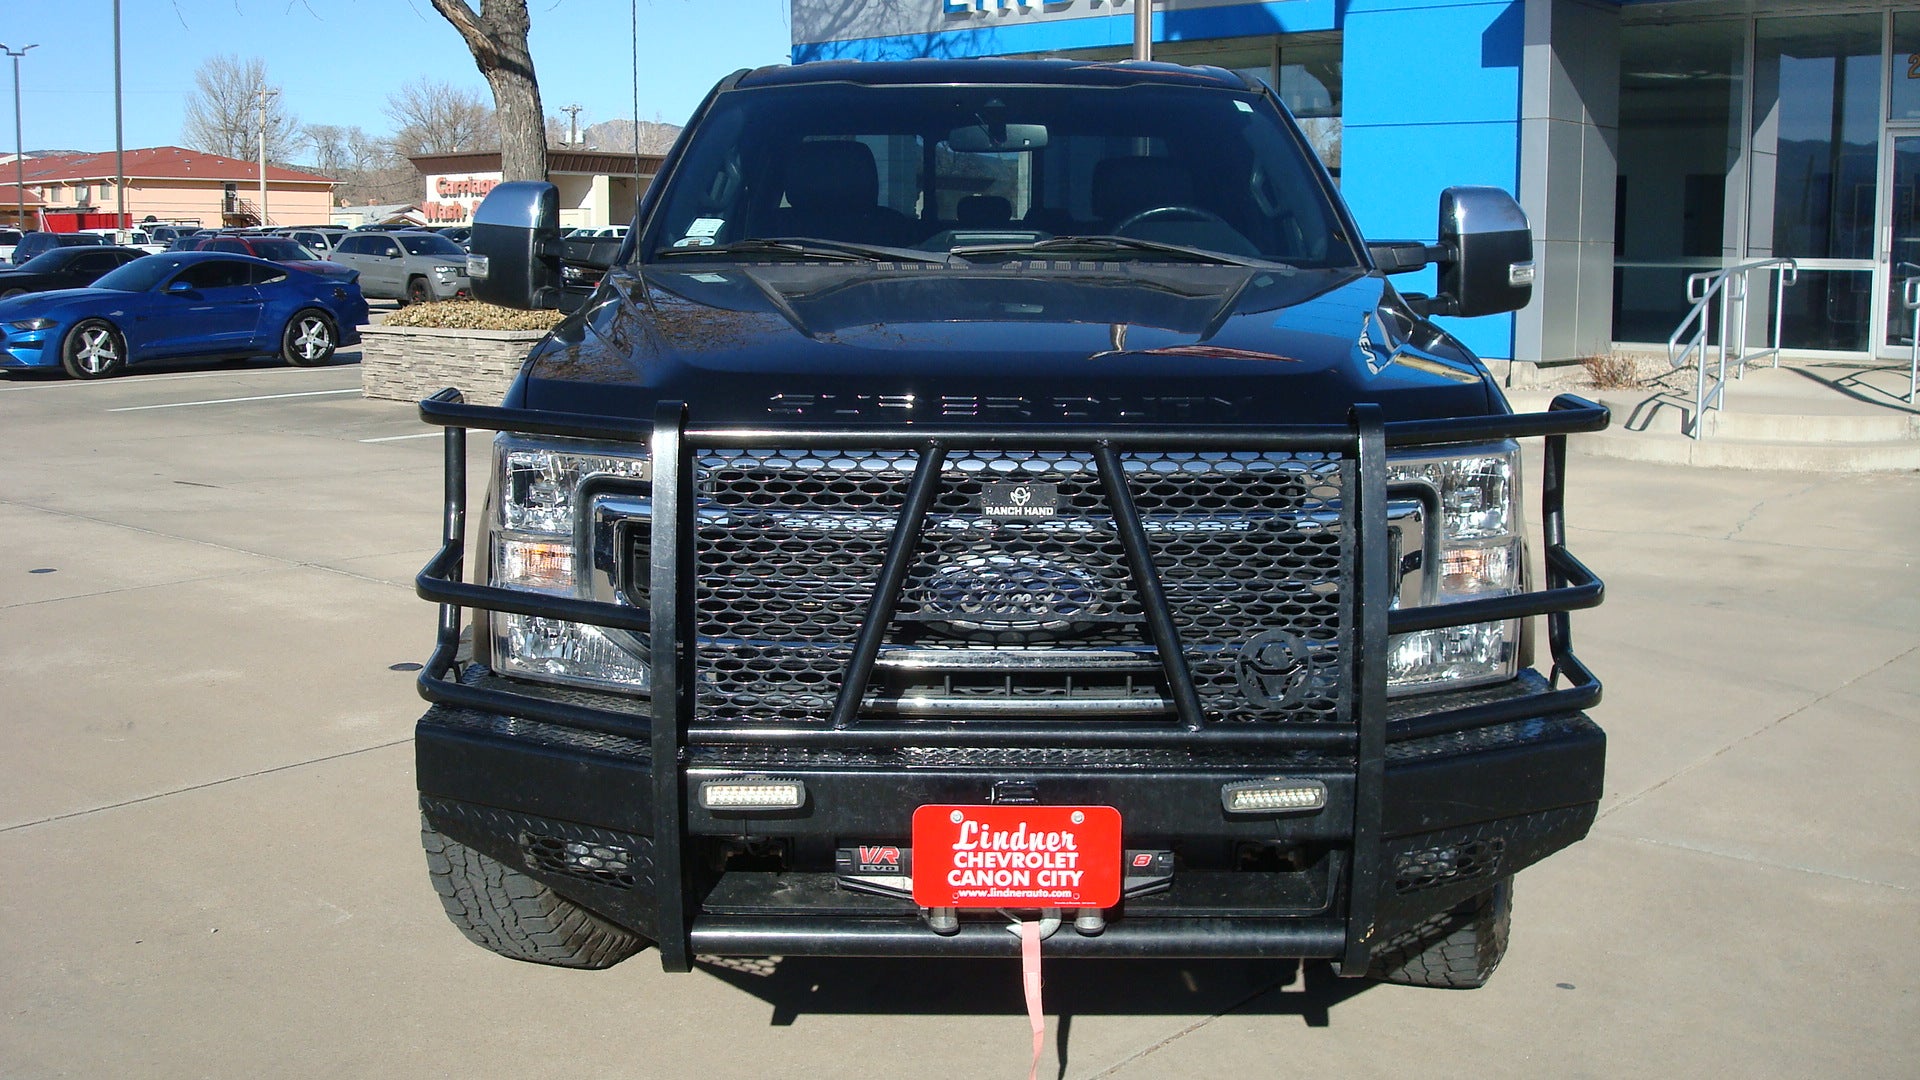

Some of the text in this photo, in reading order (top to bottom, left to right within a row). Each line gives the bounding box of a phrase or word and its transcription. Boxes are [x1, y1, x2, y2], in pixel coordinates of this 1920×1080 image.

[985, 506, 1054, 516] RANCH HAND
[952, 820, 1078, 852] Lindner
[859, 845, 900, 865] VR
[953, 851, 1079, 869] CHEVROLET
[947, 869, 1084, 887] CANON CITY
[958, 887, 1072, 898] www.lindnerauto.com
